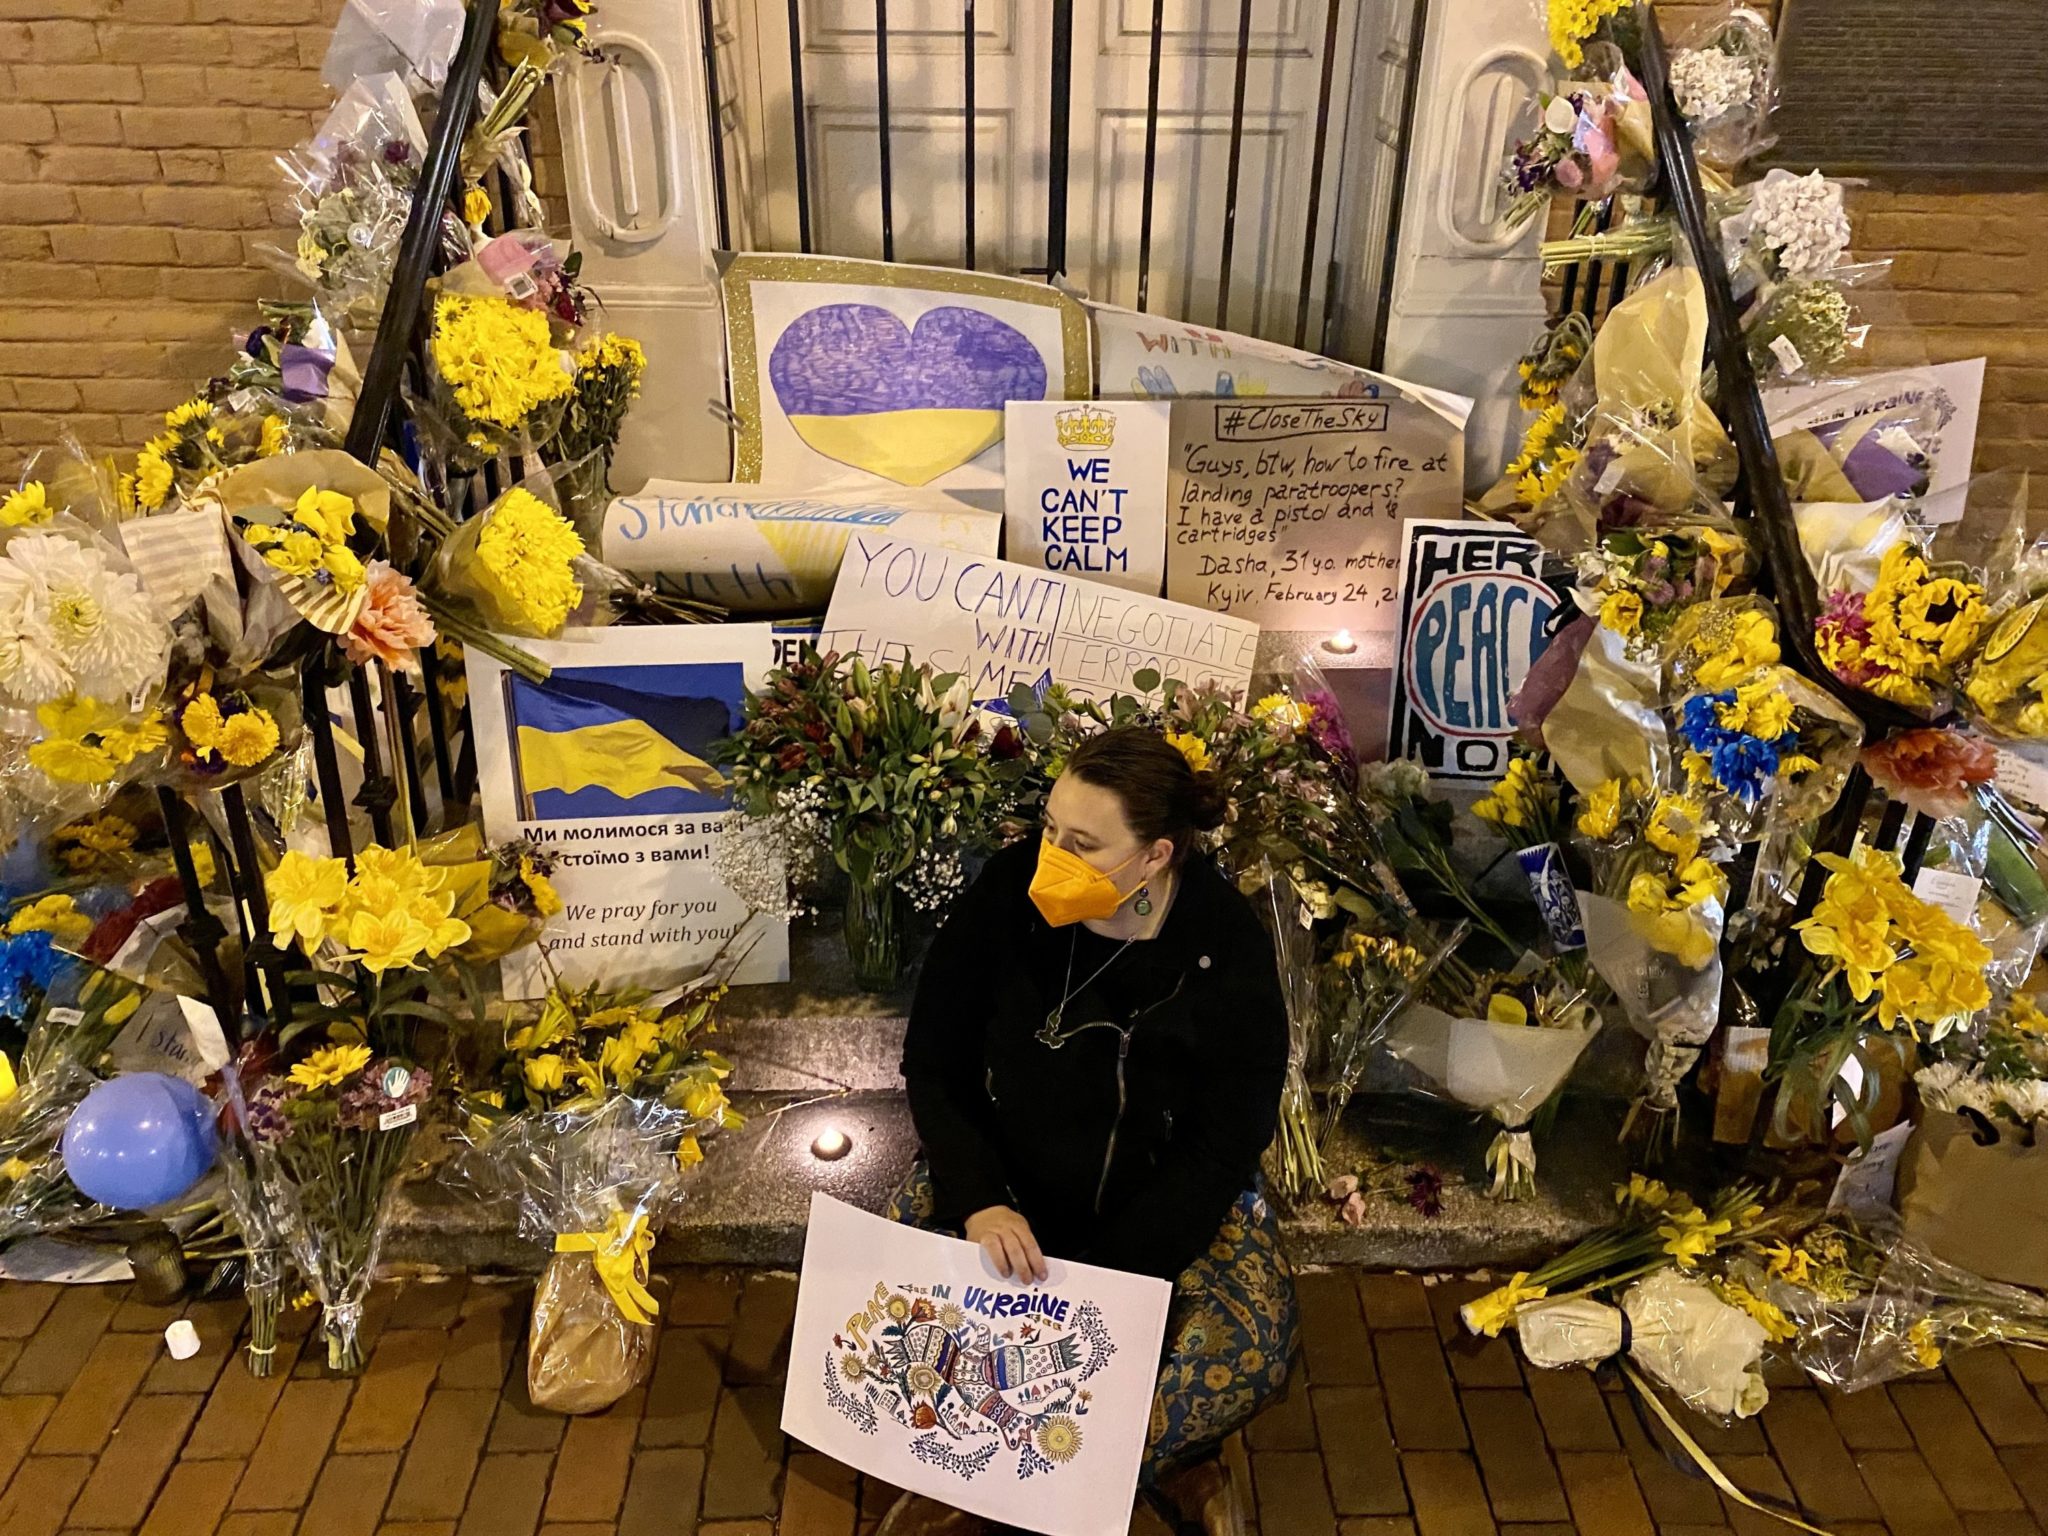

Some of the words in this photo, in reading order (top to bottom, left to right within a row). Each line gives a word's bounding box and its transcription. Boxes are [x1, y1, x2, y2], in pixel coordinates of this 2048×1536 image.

[1223, 406, 1379, 436] #CloseTheSky
[1067, 458, 1110, 483] WE
[1303, 446, 1340, 476] how
[1344, 446, 1368, 476] to
[1374, 446, 1414, 476] fire
[1422, 455, 1448, 475] at
[1041, 487, 1128, 514] CAN'T
[1181, 479, 1252, 507] landing
[1263, 478, 1405, 508] paratroopers?
[1042, 515, 1122, 545] KEEP
[1177, 505, 1192, 526] I
[1200, 505, 1242, 526] have
[1249, 510, 1264, 526] a
[1273, 504, 1329, 530] pistol
[1337, 502, 1374, 519] and
[1044, 544, 1127, 572] CALM
[1197, 552, 1276, 578] Dasha,
[1281, 550, 1310, 572] 31
[858, 536, 948, 602] YOU
[1064, 587, 1259, 673] NEGOTIATE
[1264, 582, 1338, 605] February
[1342, 583, 1369, 602] 24
[975, 617, 1051, 665] WITH
[524, 826, 557, 843] Ми
[563, 823, 669, 841] молимося
[674, 822, 696, 836] за
[702, 821, 732, 834] ва
[563, 850, 630, 867] стоїмо
[635, 851, 646, 864] з
[650, 843, 710, 863] вами!
[566, 903, 596, 921] We
[601, 904, 646, 924] pray
[649, 898, 679, 921] for
[681, 900, 718, 919] you
[550, 932, 586, 951] and
[590, 928, 645, 948] stand
[650, 925, 692, 944] with
[846, 1280, 890, 1351] PEACE
[930, 1283, 952, 1300] IN
